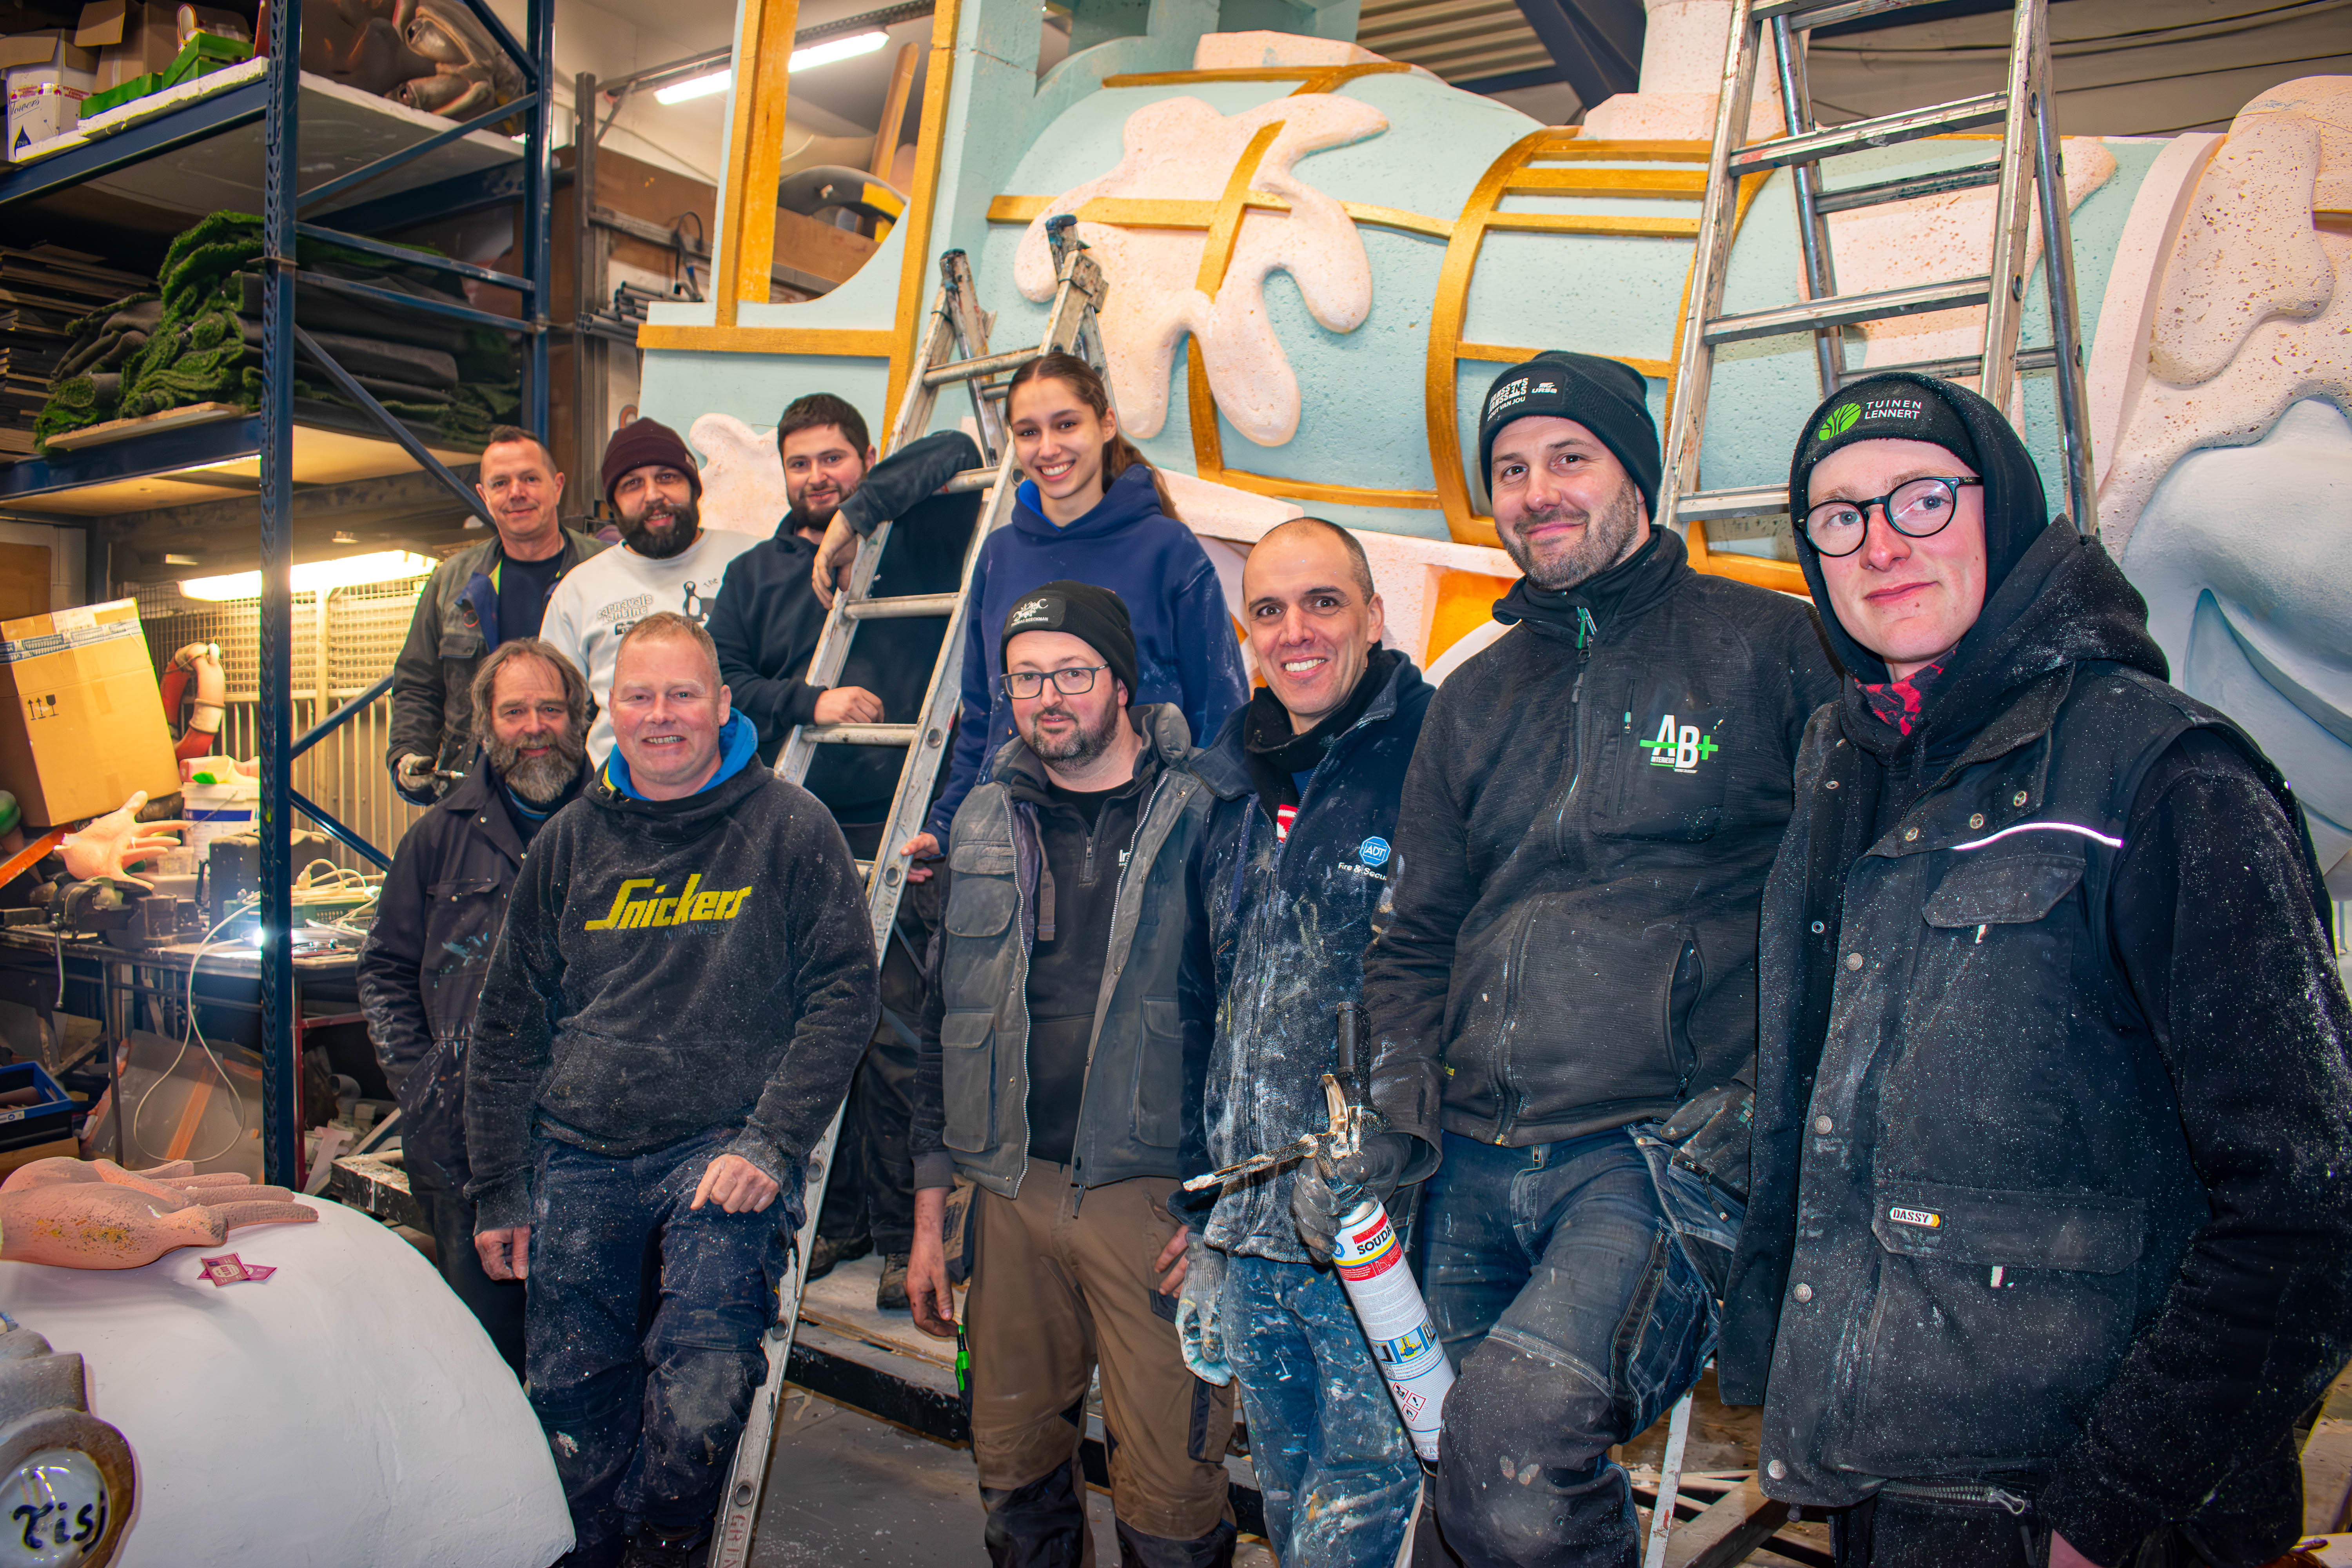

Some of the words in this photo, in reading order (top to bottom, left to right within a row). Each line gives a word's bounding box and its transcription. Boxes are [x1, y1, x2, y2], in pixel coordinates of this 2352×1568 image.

[1499, 400, 1512, 410] VAN
[1512, 396, 1526, 405] JOU
[1866, 399, 1922, 409] TUINEN
[1864, 409, 1920, 419] LENNERT
[1365, 845, 1386, 857] ADT
[1338, 862, 1352, 871] Fire
[1354, 864, 1361, 873] &
[584, 873, 752, 930] Snickers
[1893, 1209, 1929, 1223] DASSY
[1357, 1223, 1393, 1255] SOUDA
